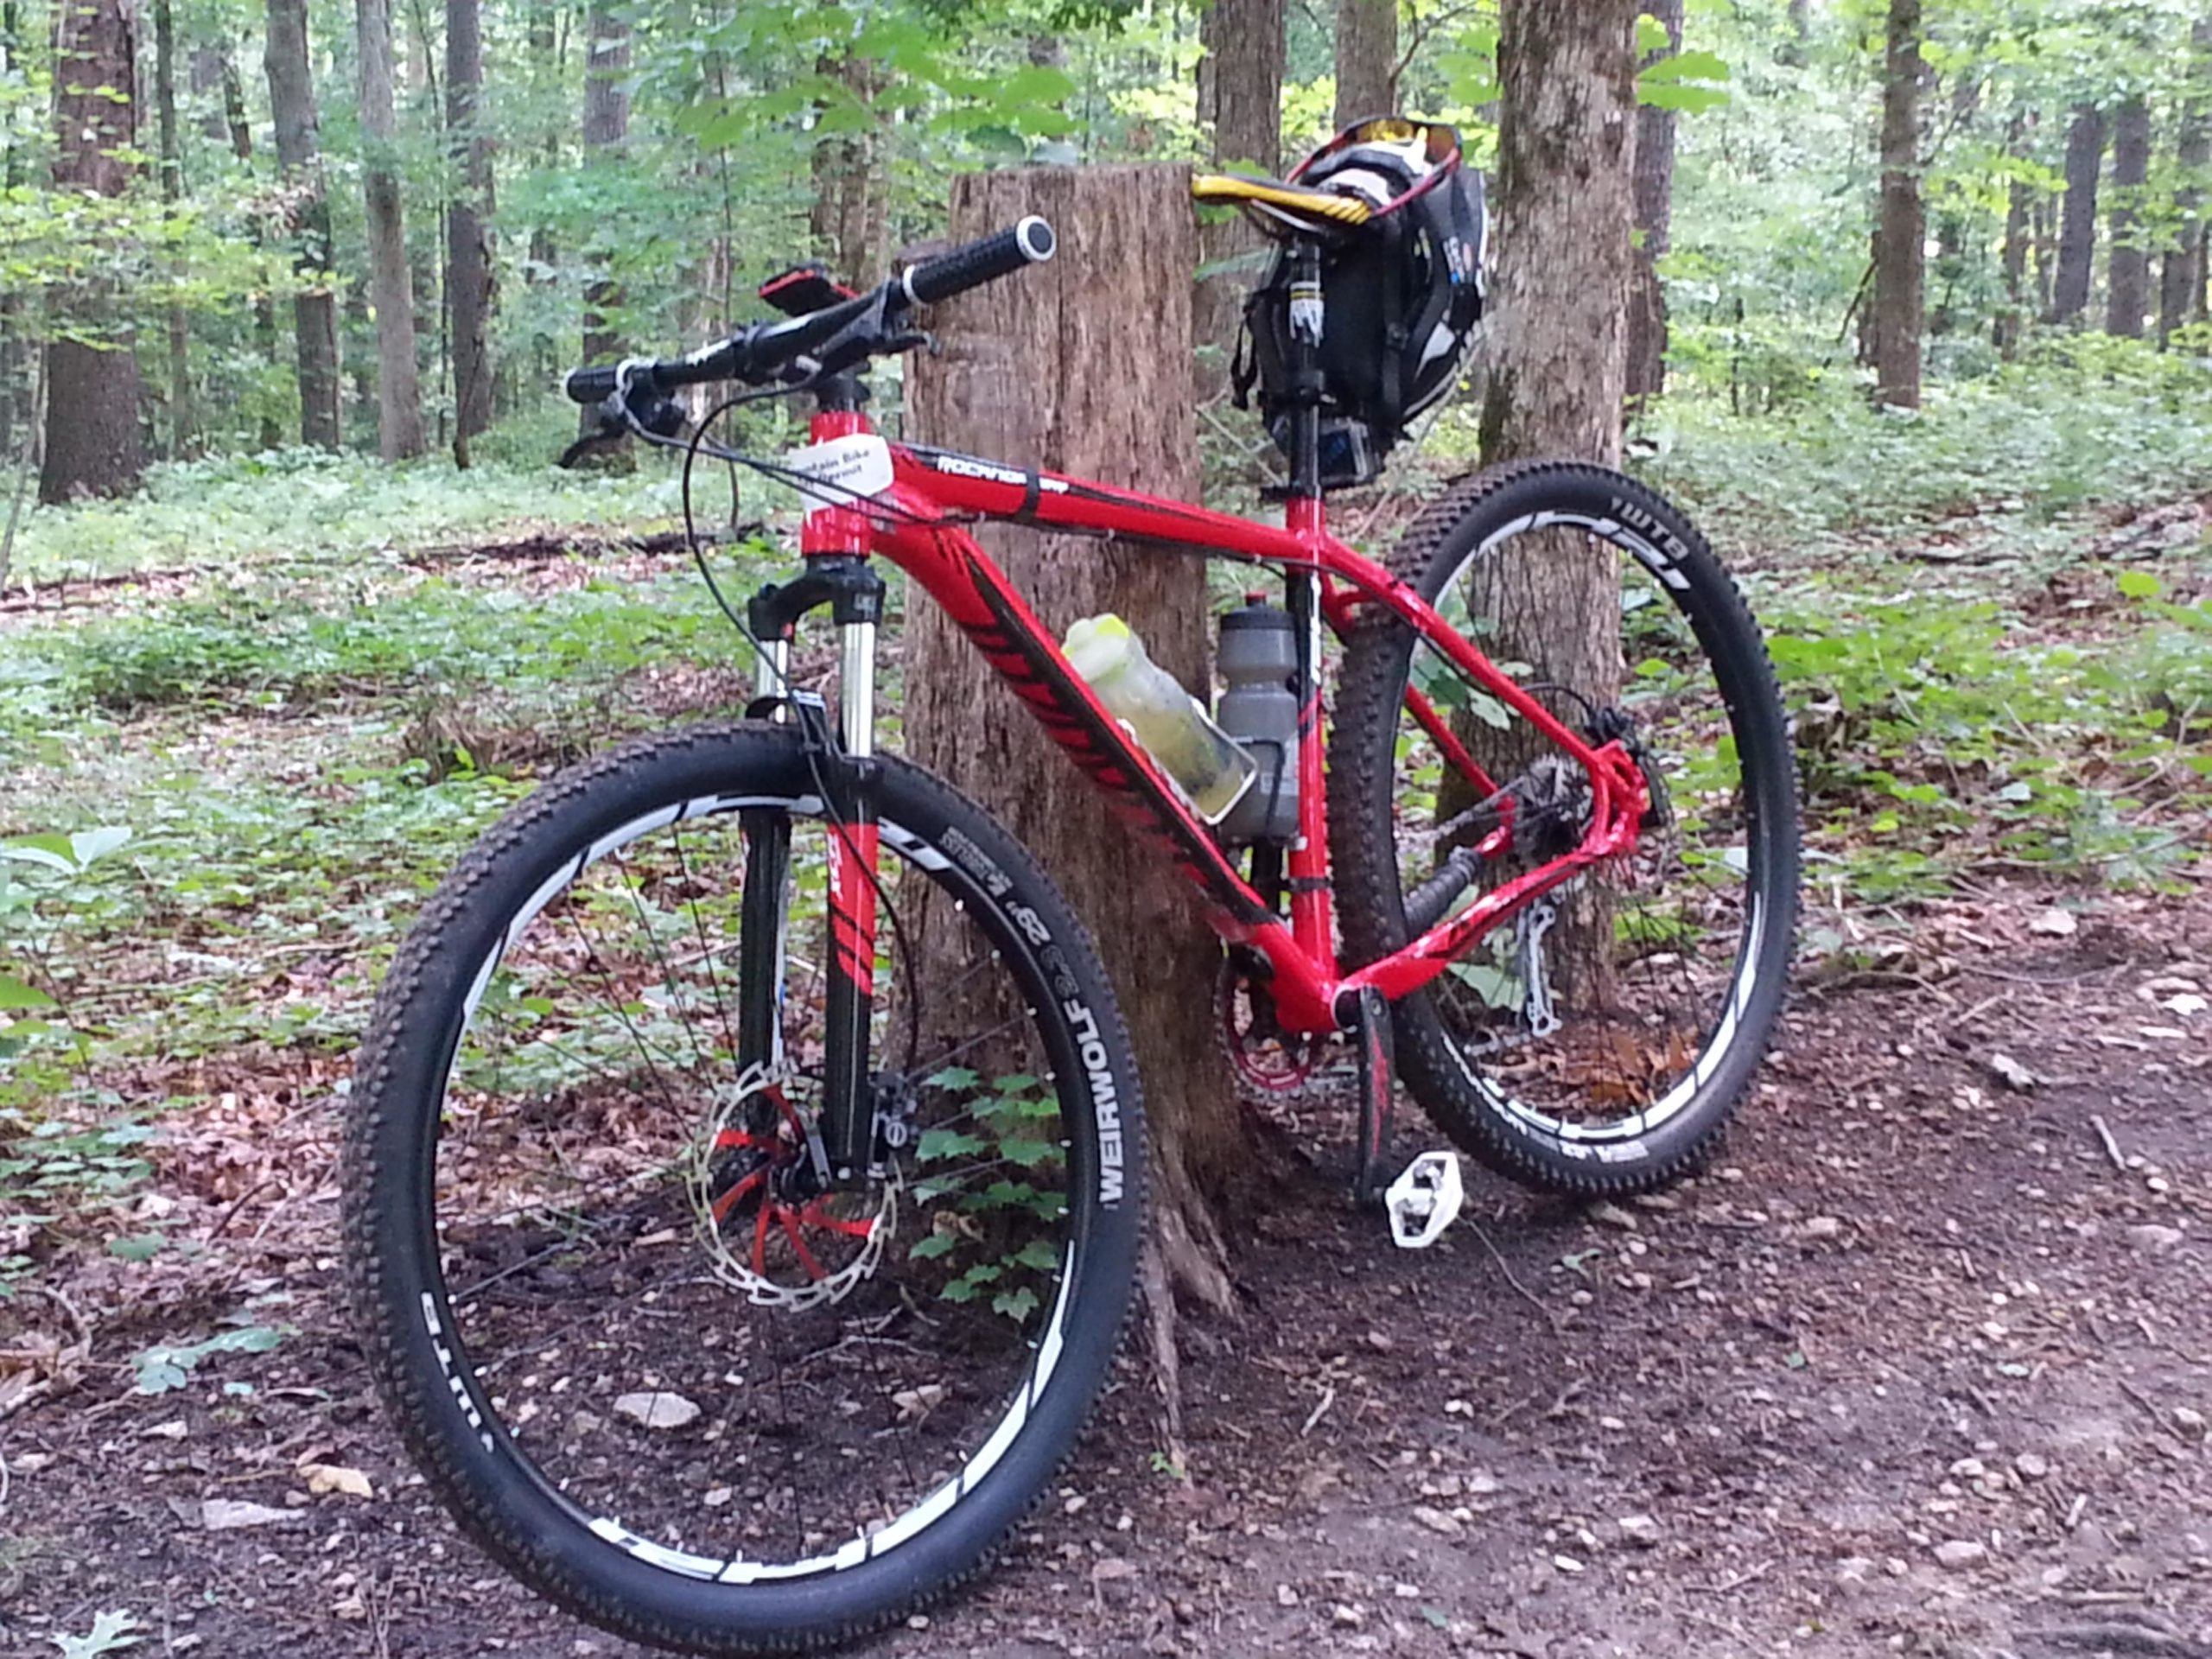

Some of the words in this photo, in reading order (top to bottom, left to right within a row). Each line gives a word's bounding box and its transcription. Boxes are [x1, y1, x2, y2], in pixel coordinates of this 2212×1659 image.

[842, 448, 869, 463] Bike
[1619, 503, 1690, 562] WTB
[1064, 1000, 1122, 1205] WEIRWOLF
